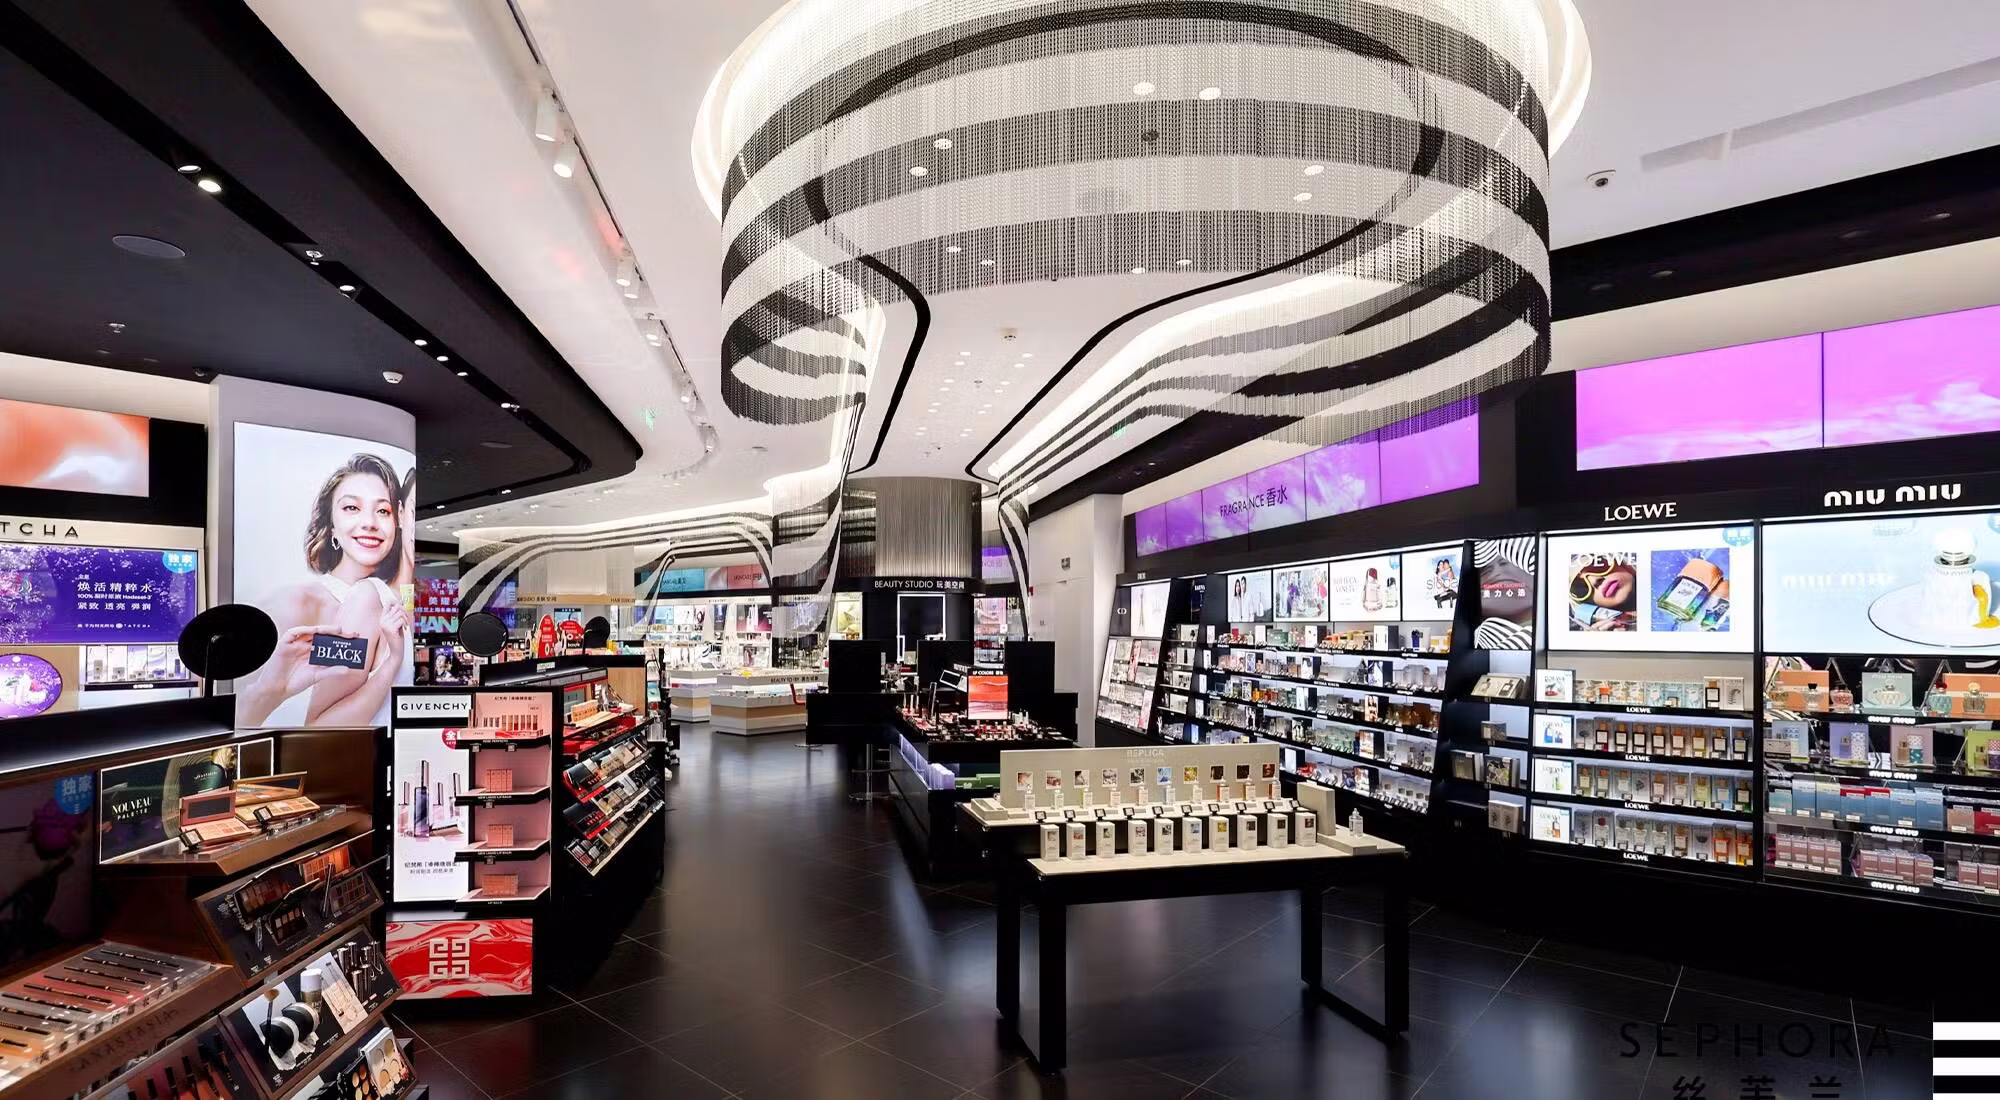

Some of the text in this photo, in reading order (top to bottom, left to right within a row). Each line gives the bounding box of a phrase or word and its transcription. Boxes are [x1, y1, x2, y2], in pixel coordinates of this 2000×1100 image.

[1219, 485, 1288, 517] FRAGRANCE 香水
[1604, 502, 1678, 521] LOEWE
[1570, 552, 1637, 567] LOEWE
[77, 582, 153, 592] 焕活精粹水
[936, 581, 965, 589] 玩美空间
[317, 645, 363, 662] BLACK
[401, 702, 468, 711] GIVENCHY
[1626, 706, 1652, 714] LOEWE
[1126, 749, 1164, 758] REPLICA
[1625, 754, 1651, 762] LOEWE
[62, 774, 92, 795] 独家
[112, 797, 151, 815] NOUVEAU
[1624, 802, 1650, 811] LOEWE
[1623, 853, 1649, 862] LOEWE
